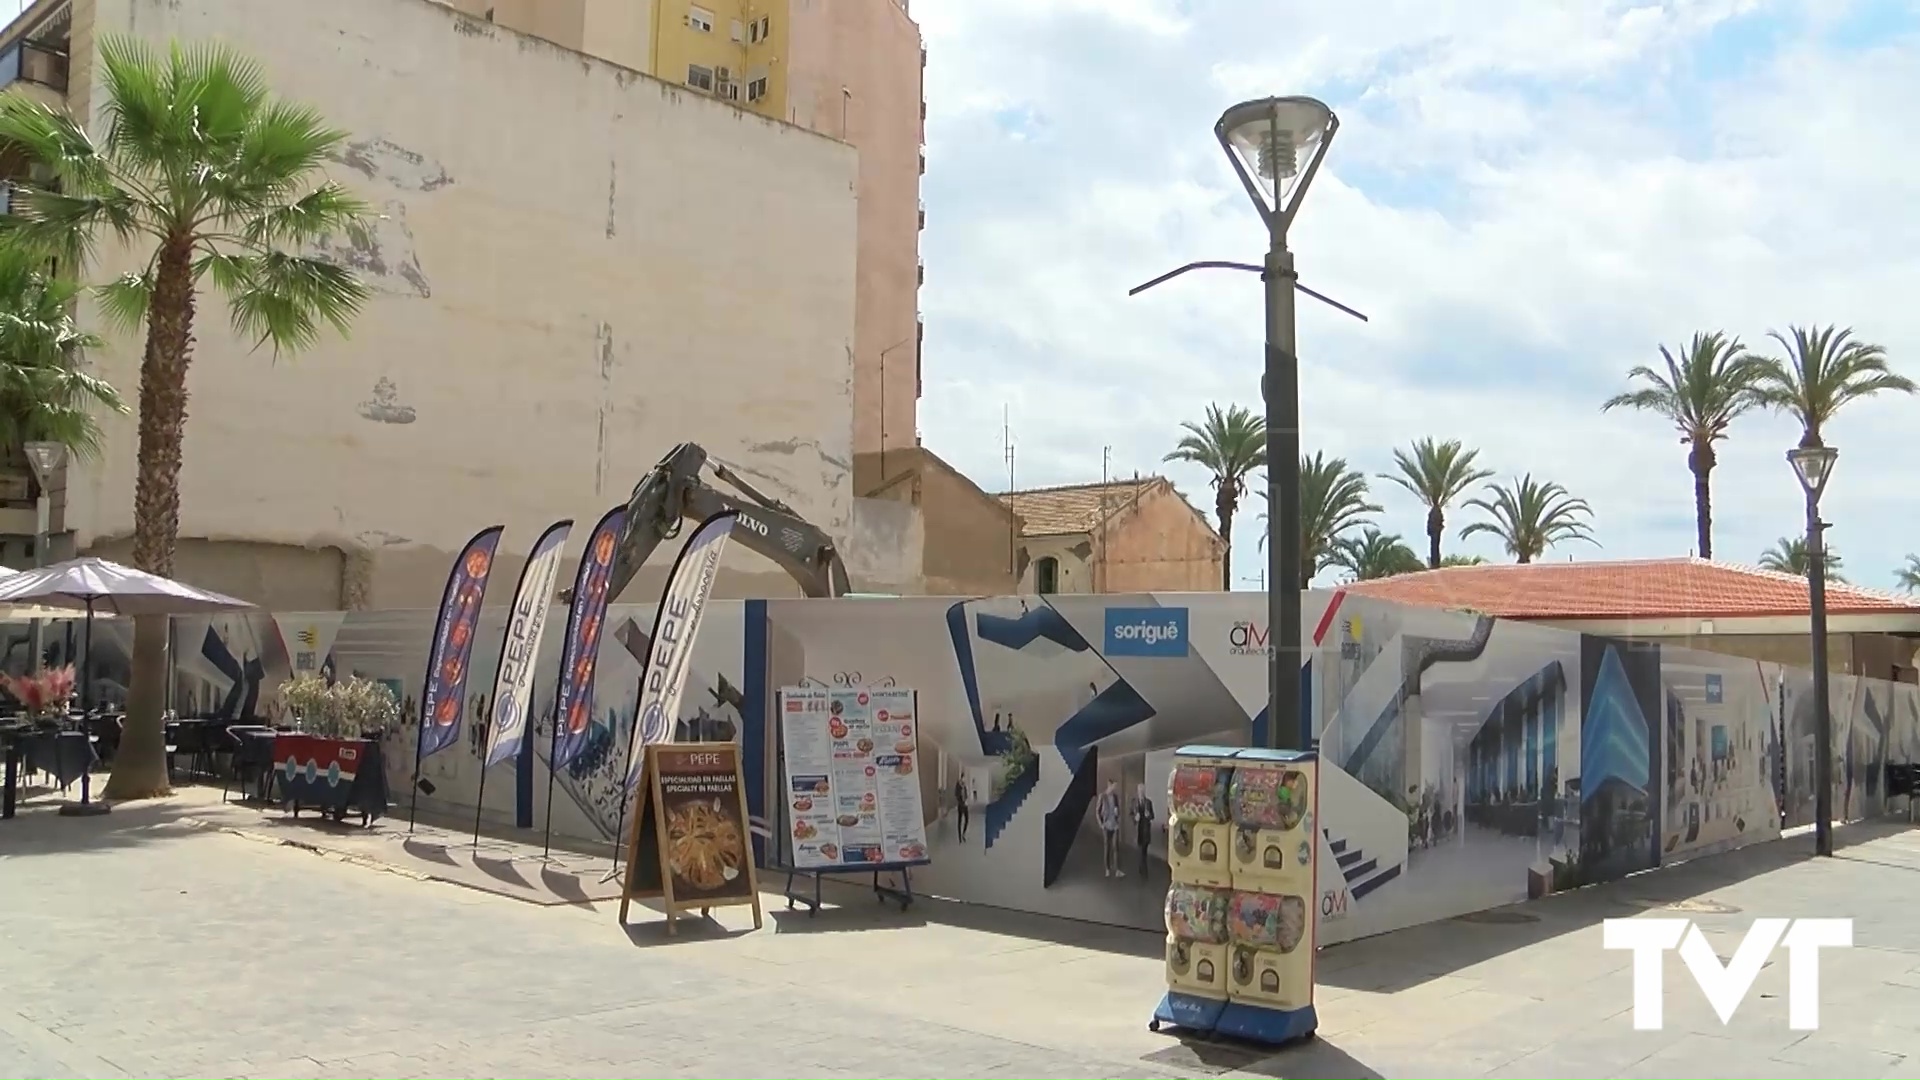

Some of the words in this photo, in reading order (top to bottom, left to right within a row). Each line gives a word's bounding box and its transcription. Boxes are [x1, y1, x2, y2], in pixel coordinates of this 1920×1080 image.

[502, 595, 534, 685] PEPE
[650, 592, 688, 693] PEPE
[424, 682, 439, 728] PEPE
[557, 683, 570, 737] PEPE
[661, 775, 702, 785] ESPECIALIDAD
[703, 775, 711, 783] EN
[712, 774, 736, 783] PAELLAS
[690, 752, 721, 766] PEPE
[666, 785, 698, 794] SPECIALTY
[707, 783, 732, 793] PAELLAS
